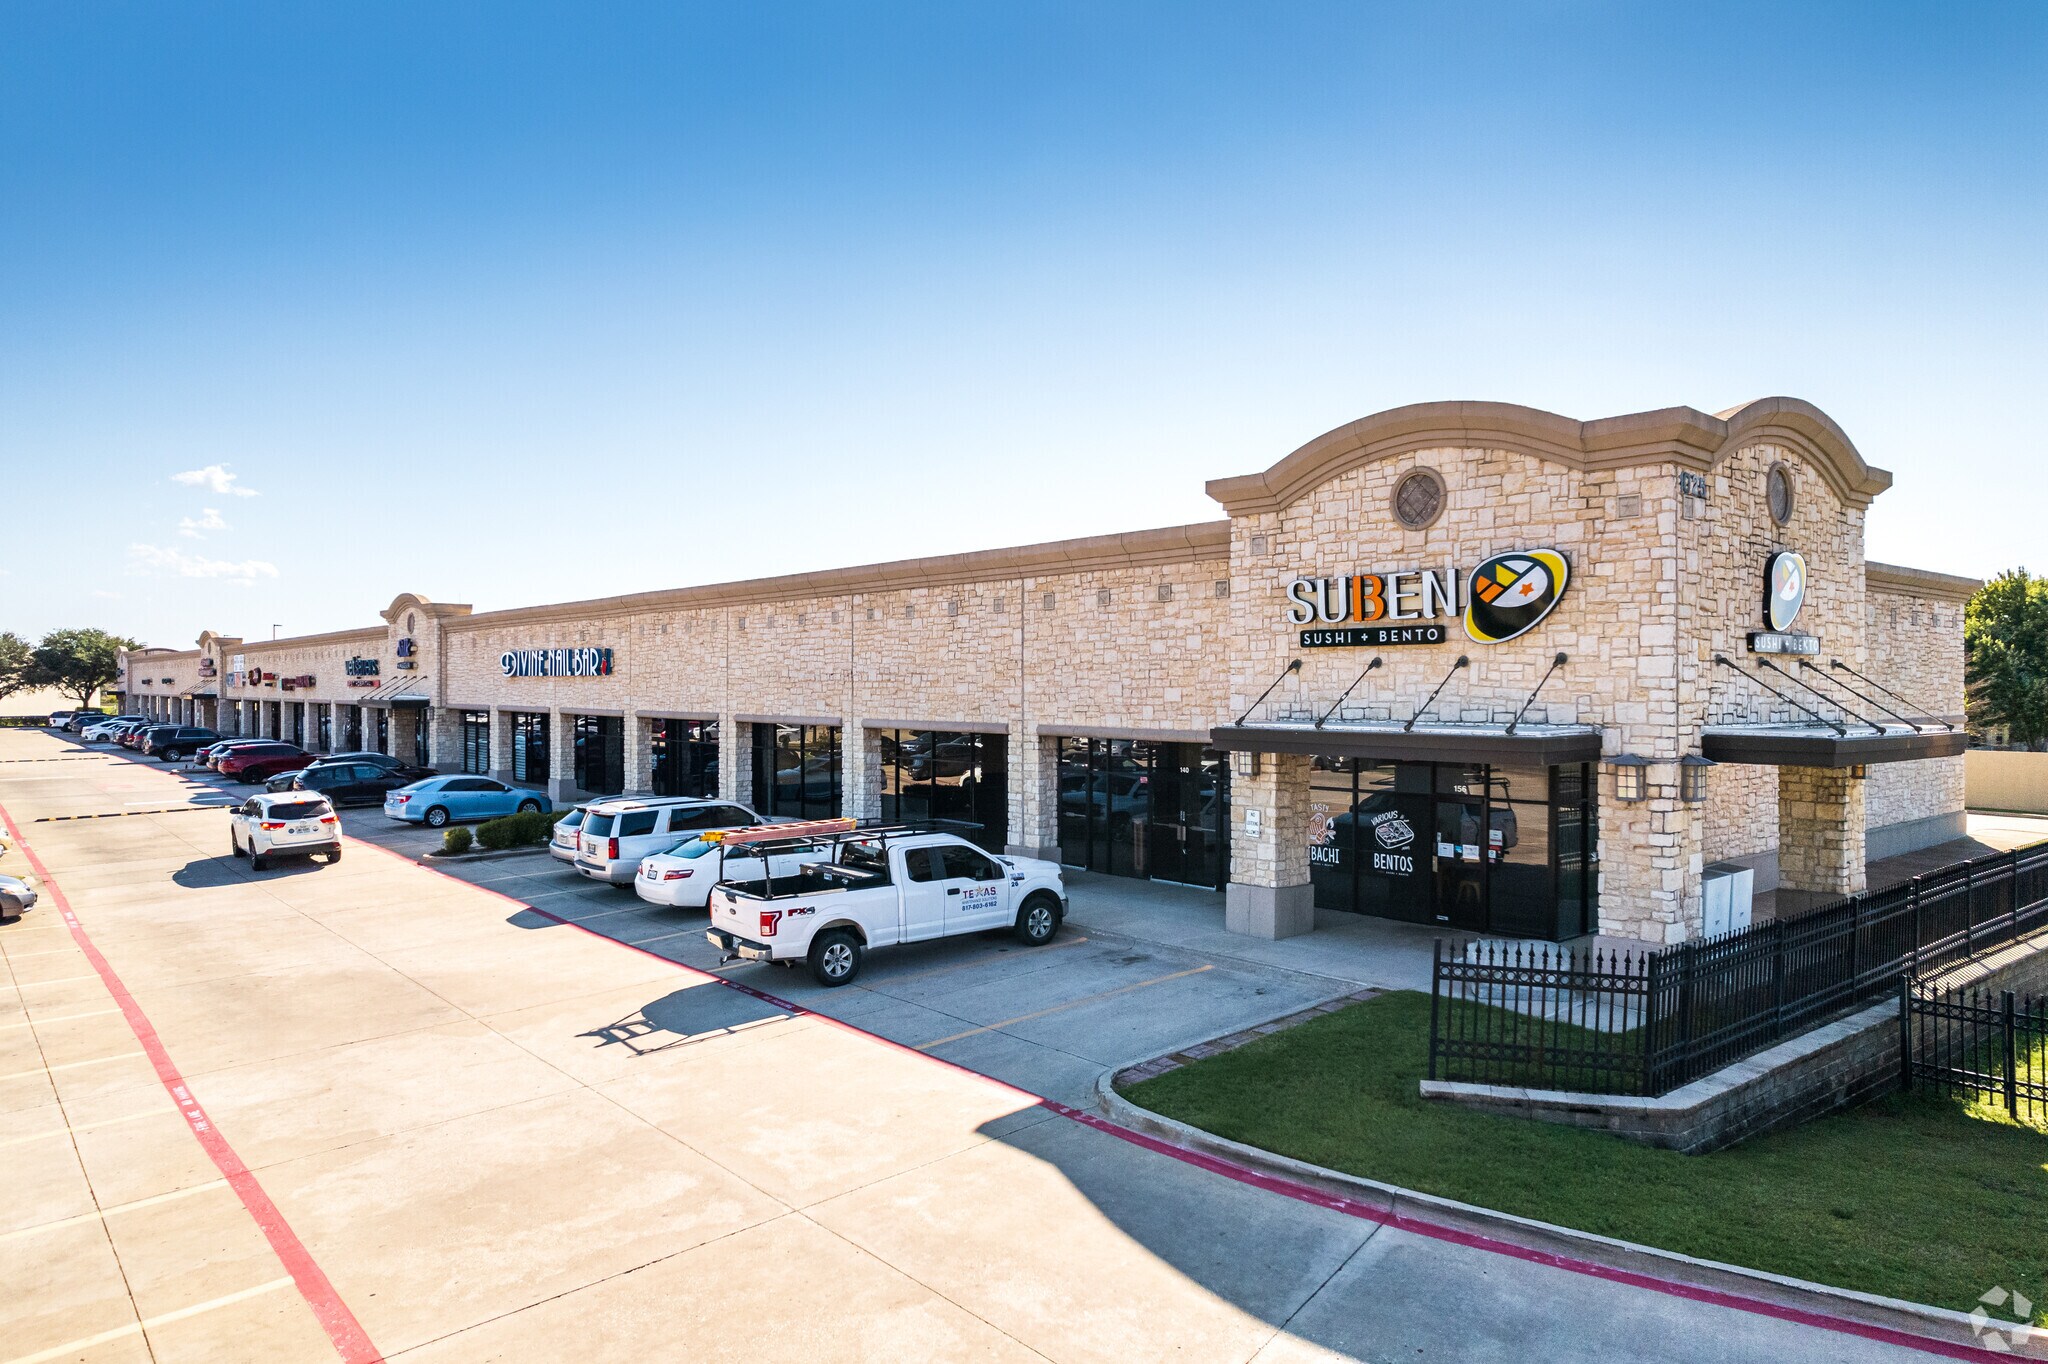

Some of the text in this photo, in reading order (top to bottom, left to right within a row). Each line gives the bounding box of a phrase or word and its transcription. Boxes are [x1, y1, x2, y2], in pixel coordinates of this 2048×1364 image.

[1286, 568, 1459, 624] SUBEN
[1303, 632, 1351, 645] SUSHI
[1379, 628, 1439, 642] BENTO
[1755, 636, 1782, 650] SUSHI
[1793, 638, 1819, 651] BENTO
[548, 649, 571, 677] NAIL
[574, 648, 599, 677] BAR
[1453, 785, 1467, 793] 156
[1310, 803, 1330, 812] TASTY
[1370, 810, 1398, 826] VARIOUS
[1373, 852, 1413, 872] BENTOS
[963, 886, 996, 899] TEXAS
